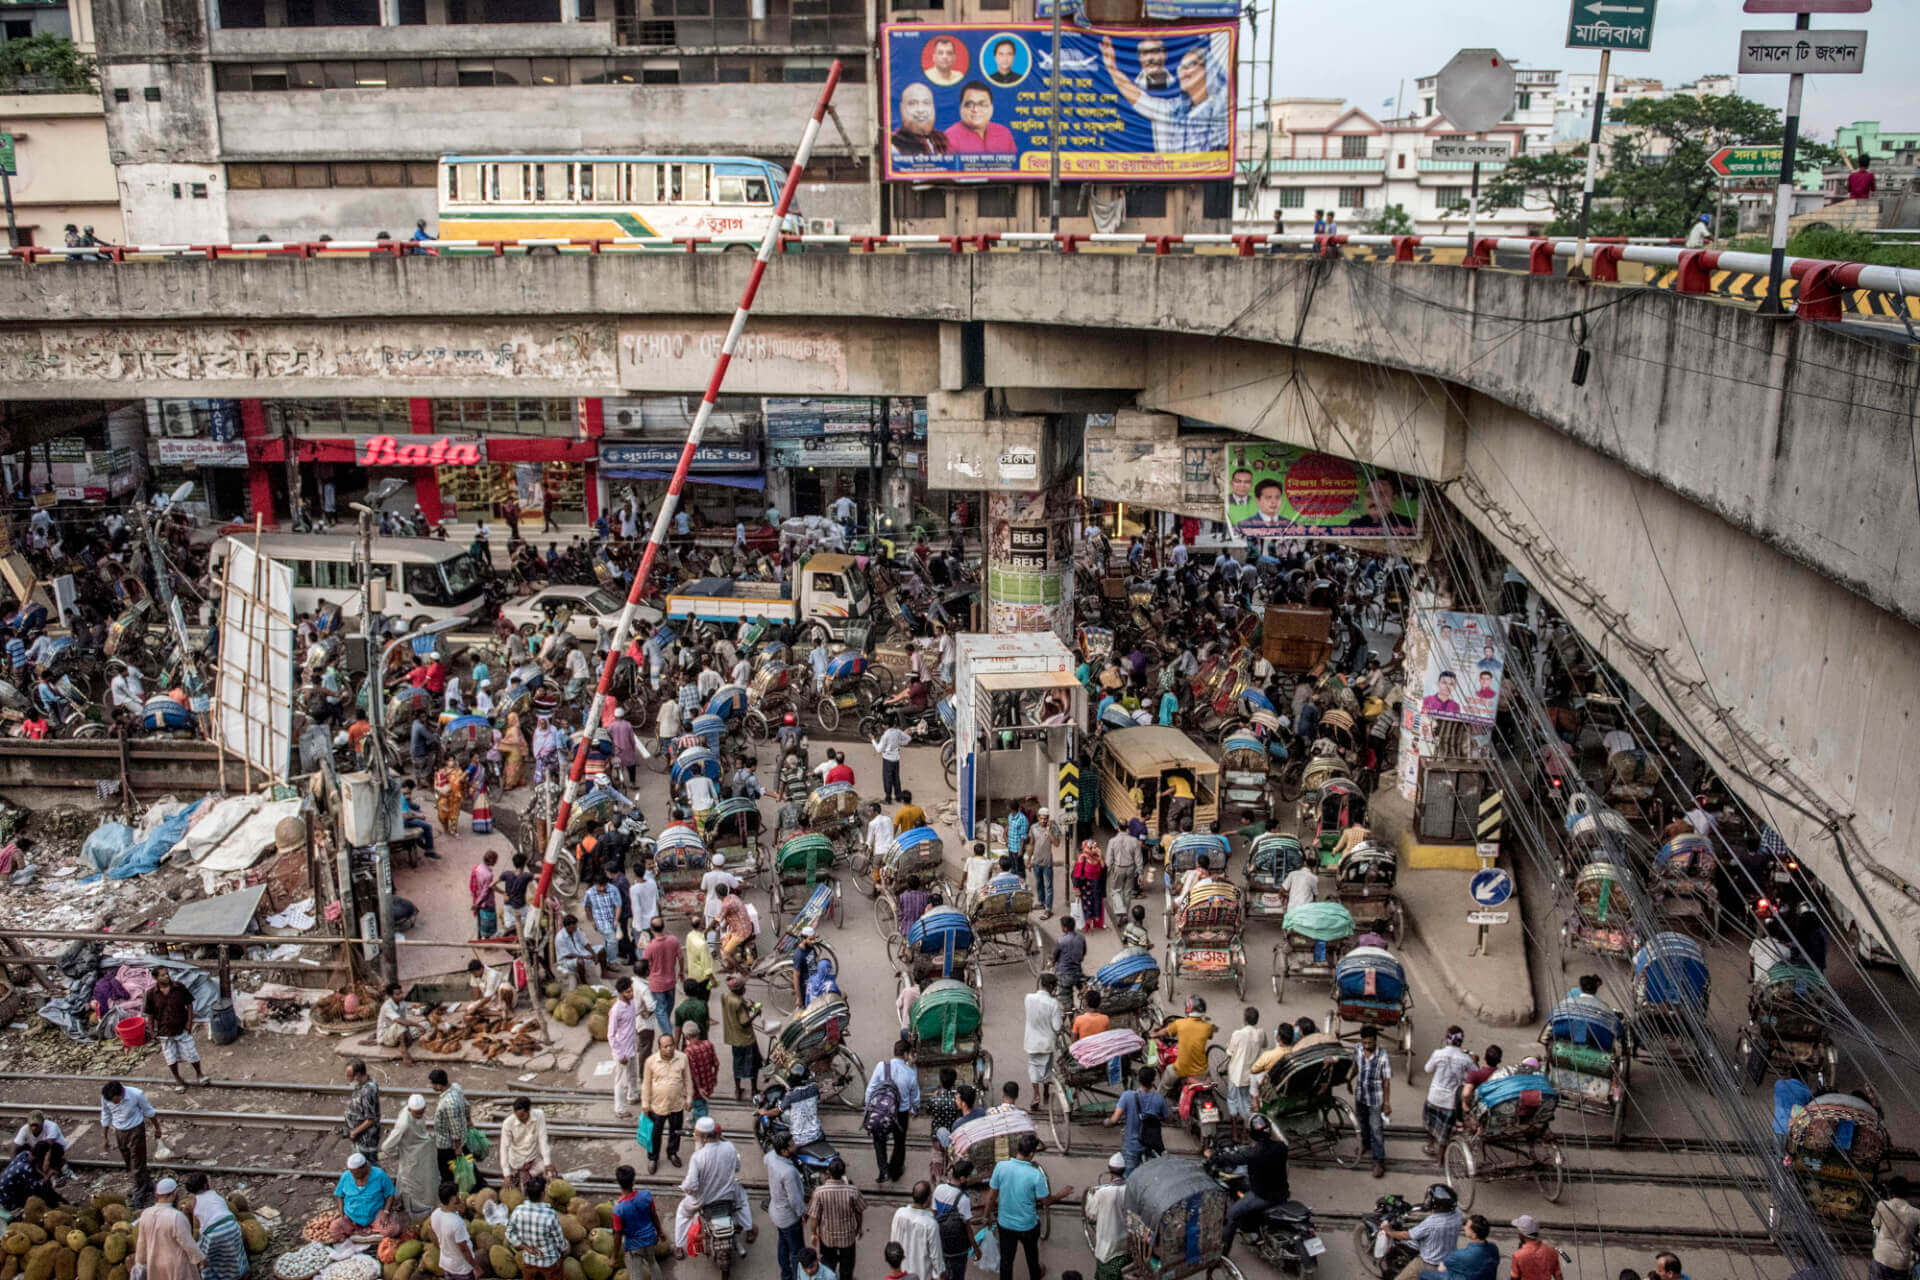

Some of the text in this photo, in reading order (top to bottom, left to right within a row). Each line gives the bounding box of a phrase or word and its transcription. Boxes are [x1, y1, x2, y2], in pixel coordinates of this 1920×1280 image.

[1574, 20, 1646, 44] মালিবাগ
[1747, 40, 1858, 62] সামনে টি জংশন
[706, 216, 743, 234] তুরাগ
[359, 434, 481, 466] Bata
[1012, 533, 1044, 544] BELS
